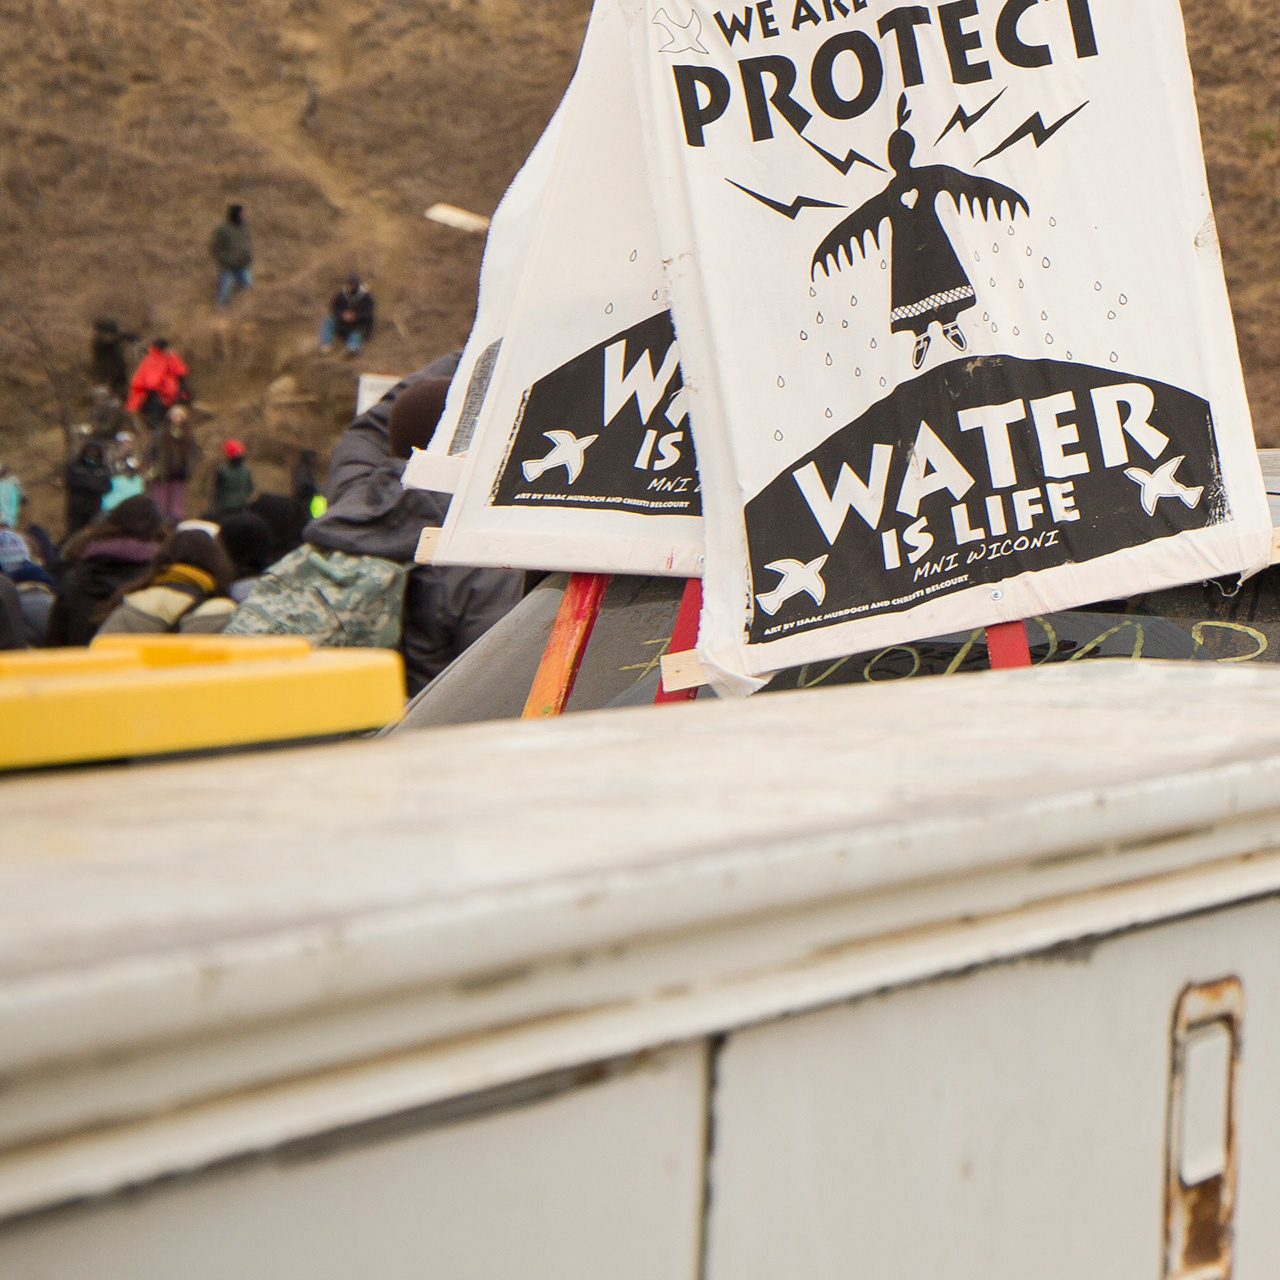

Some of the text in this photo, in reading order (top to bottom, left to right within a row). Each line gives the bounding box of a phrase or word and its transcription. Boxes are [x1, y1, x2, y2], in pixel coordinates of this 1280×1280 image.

[633, 428, 685, 471] IS
[791, 382, 1171, 546] WATER
[513, 492, 531, 501] ART
[531, 492, 543, 501] BY
[566, 494, 606, 503] MURDOCH
[605, 496, 623, 504] AND
[649, 500, 690, 509] BELCOURT
[646, 475, 693, 494] MNI
[880, 481, 1081, 571] IS LIFE
[913, 529, 1060, 583] MNI WICONI
[763, 573, 970, 636] ART BY ISAAC MURDOCH AND CHRISTI BELCOURT
